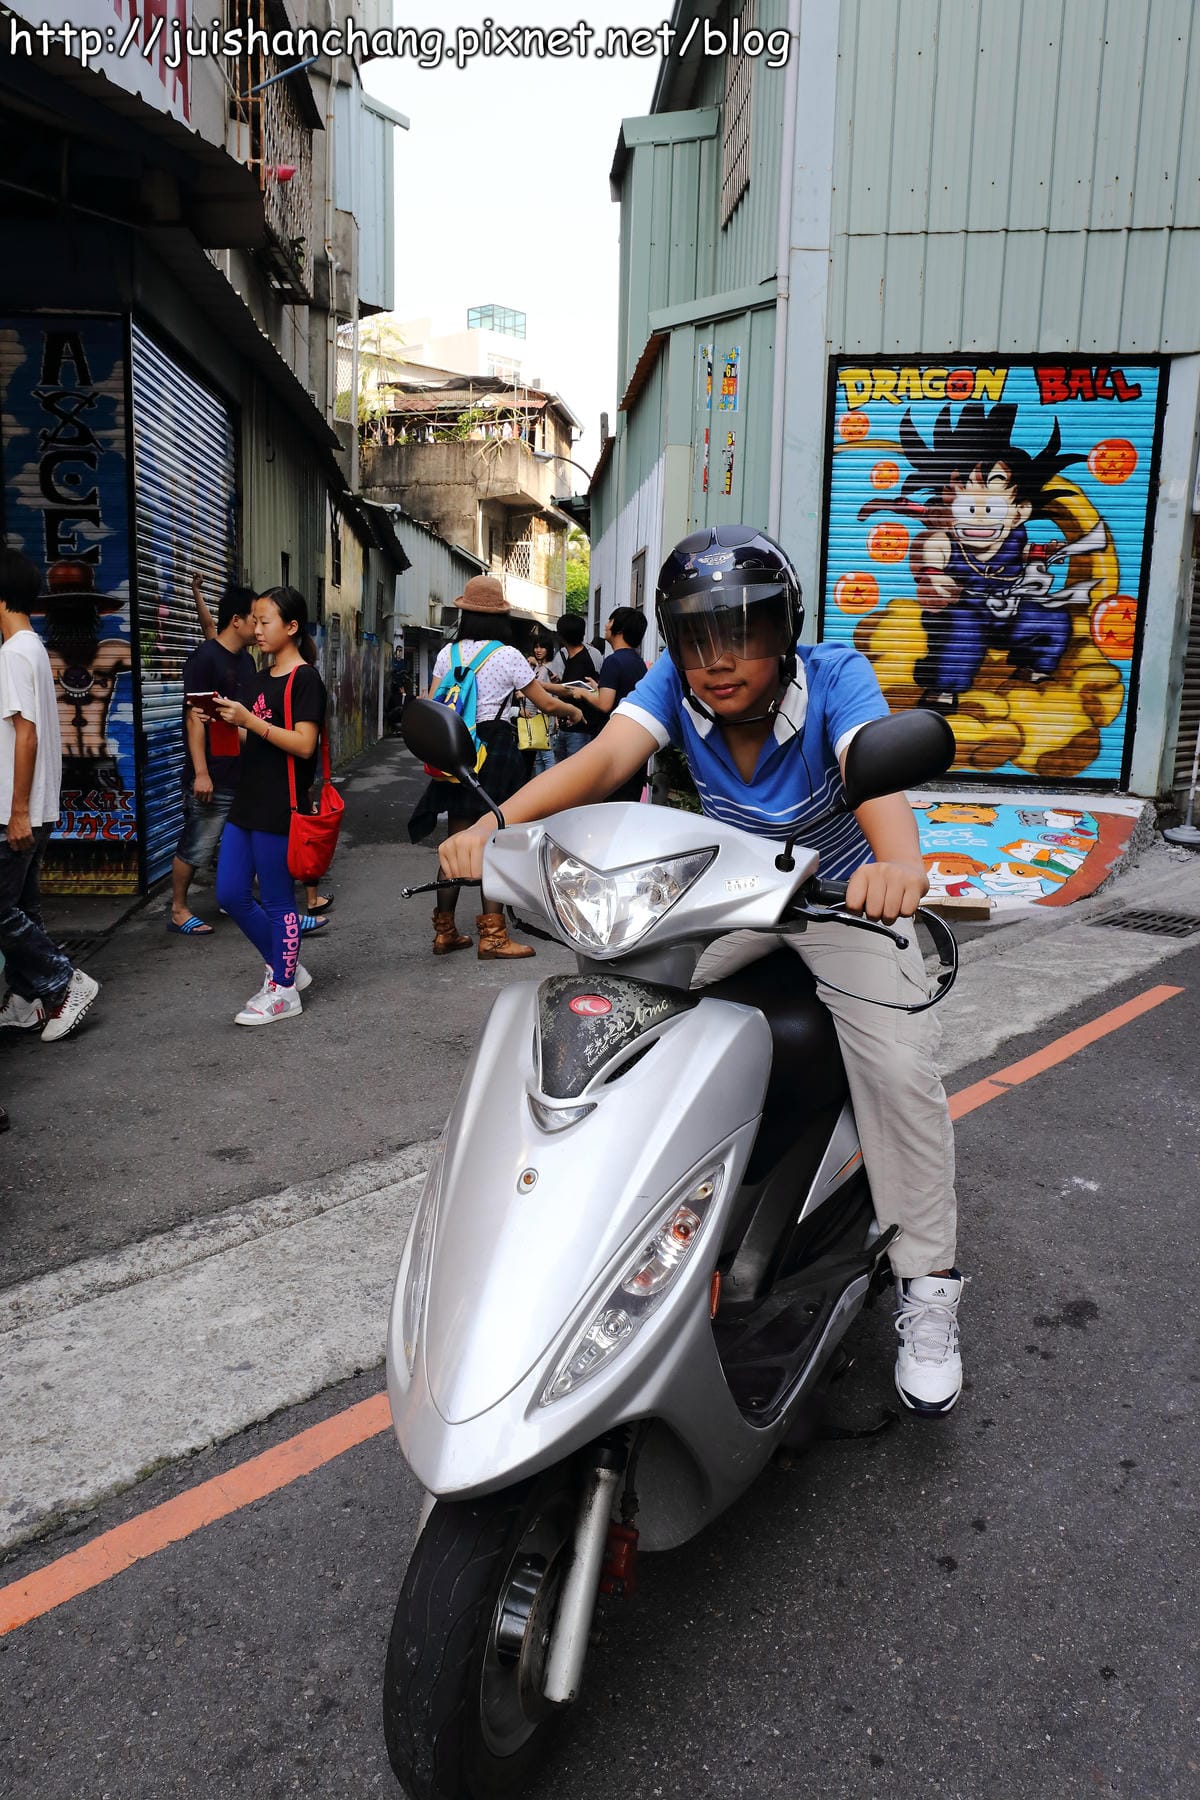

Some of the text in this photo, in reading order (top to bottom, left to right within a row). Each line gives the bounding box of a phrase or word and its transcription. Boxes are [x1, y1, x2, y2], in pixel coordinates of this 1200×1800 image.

[838, 365, 1143, 409] DRAGON BALL
[283, 912, 299, 979] adidas
